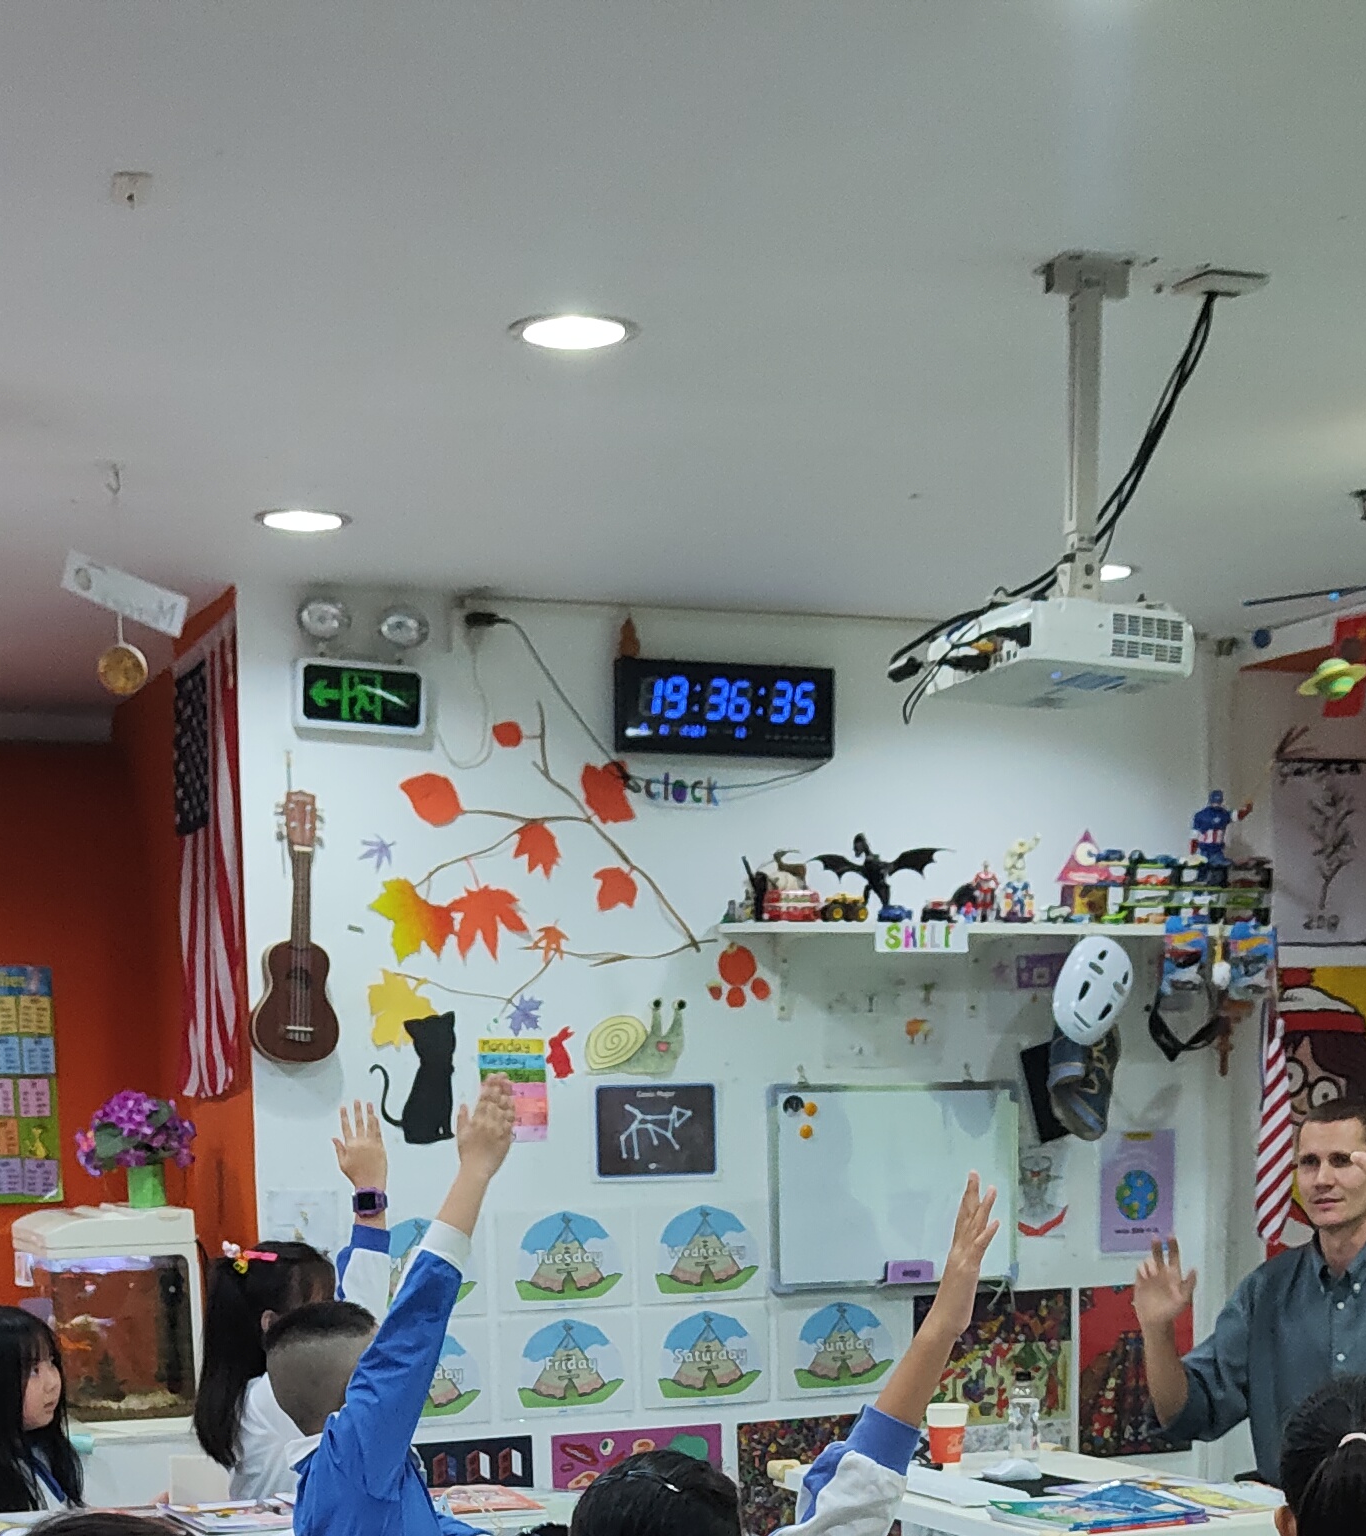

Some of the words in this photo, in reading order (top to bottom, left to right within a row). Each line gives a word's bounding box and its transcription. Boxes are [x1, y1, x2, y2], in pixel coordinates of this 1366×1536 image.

[651, 675, 815, 725] 19:36:35
[481, 1040, 531, 1054] Monday
[537, 1250, 603, 1266] Tuesday
[668, 1242, 746, 1260] Wednesday
[544, 1356, 598, 1373] Friday
[673, 1347, 748, 1364] Saturday
[816, 1337, 875, 1353] Sunday
